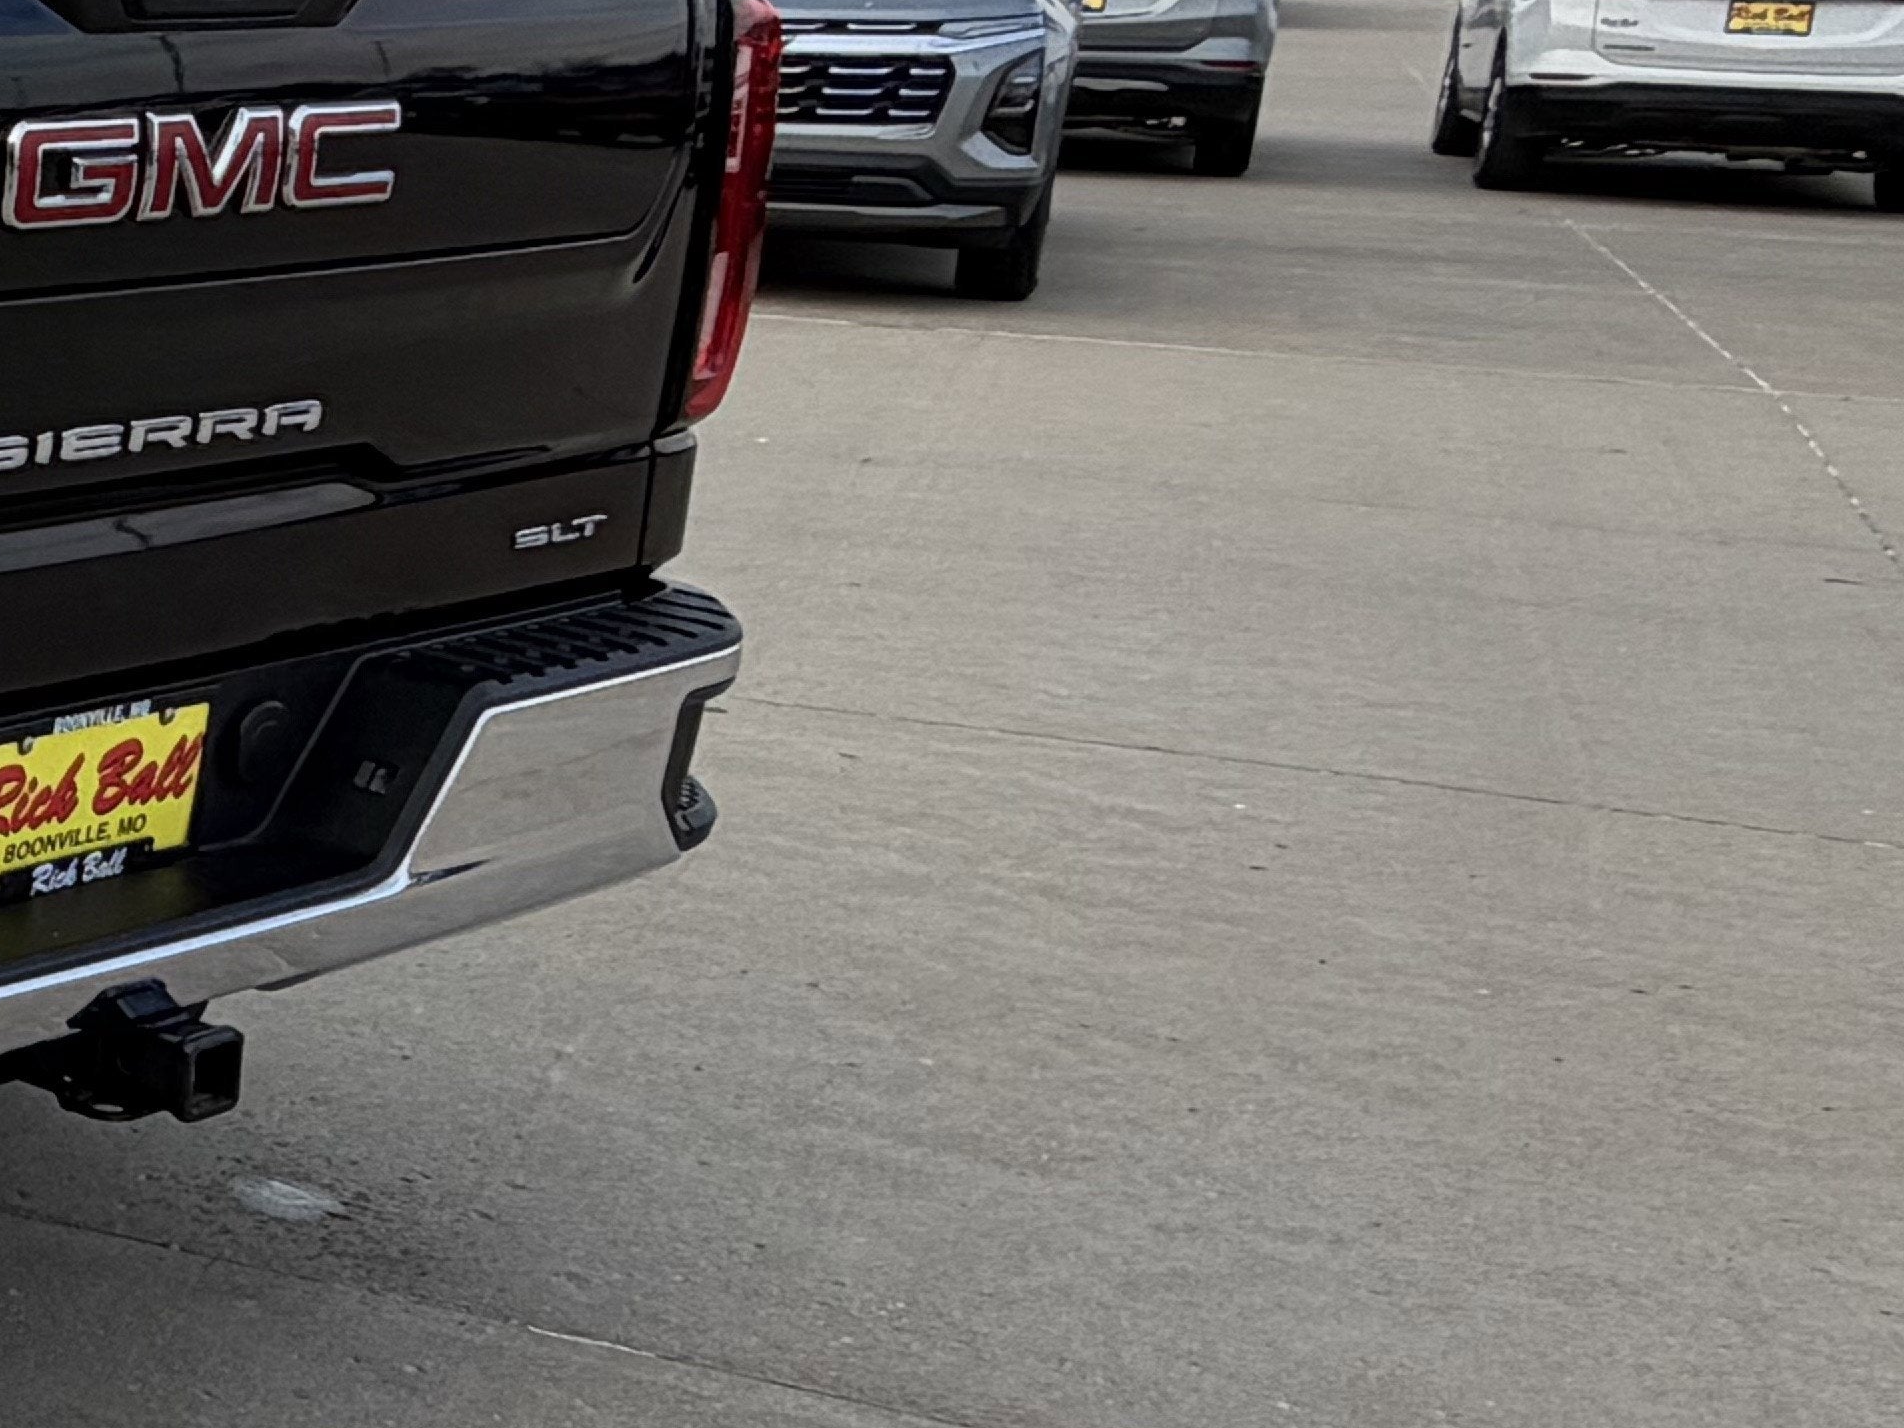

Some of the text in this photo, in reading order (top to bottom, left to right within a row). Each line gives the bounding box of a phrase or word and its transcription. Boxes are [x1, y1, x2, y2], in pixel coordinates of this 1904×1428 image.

[2, 101, 401, 229] GMC
[514, 514, 608, 550] SLT
[92, 732, 204, 816] Ball
[117, 813, 147, 836] MO
[30, 846, 127, 898] Rick Ball
